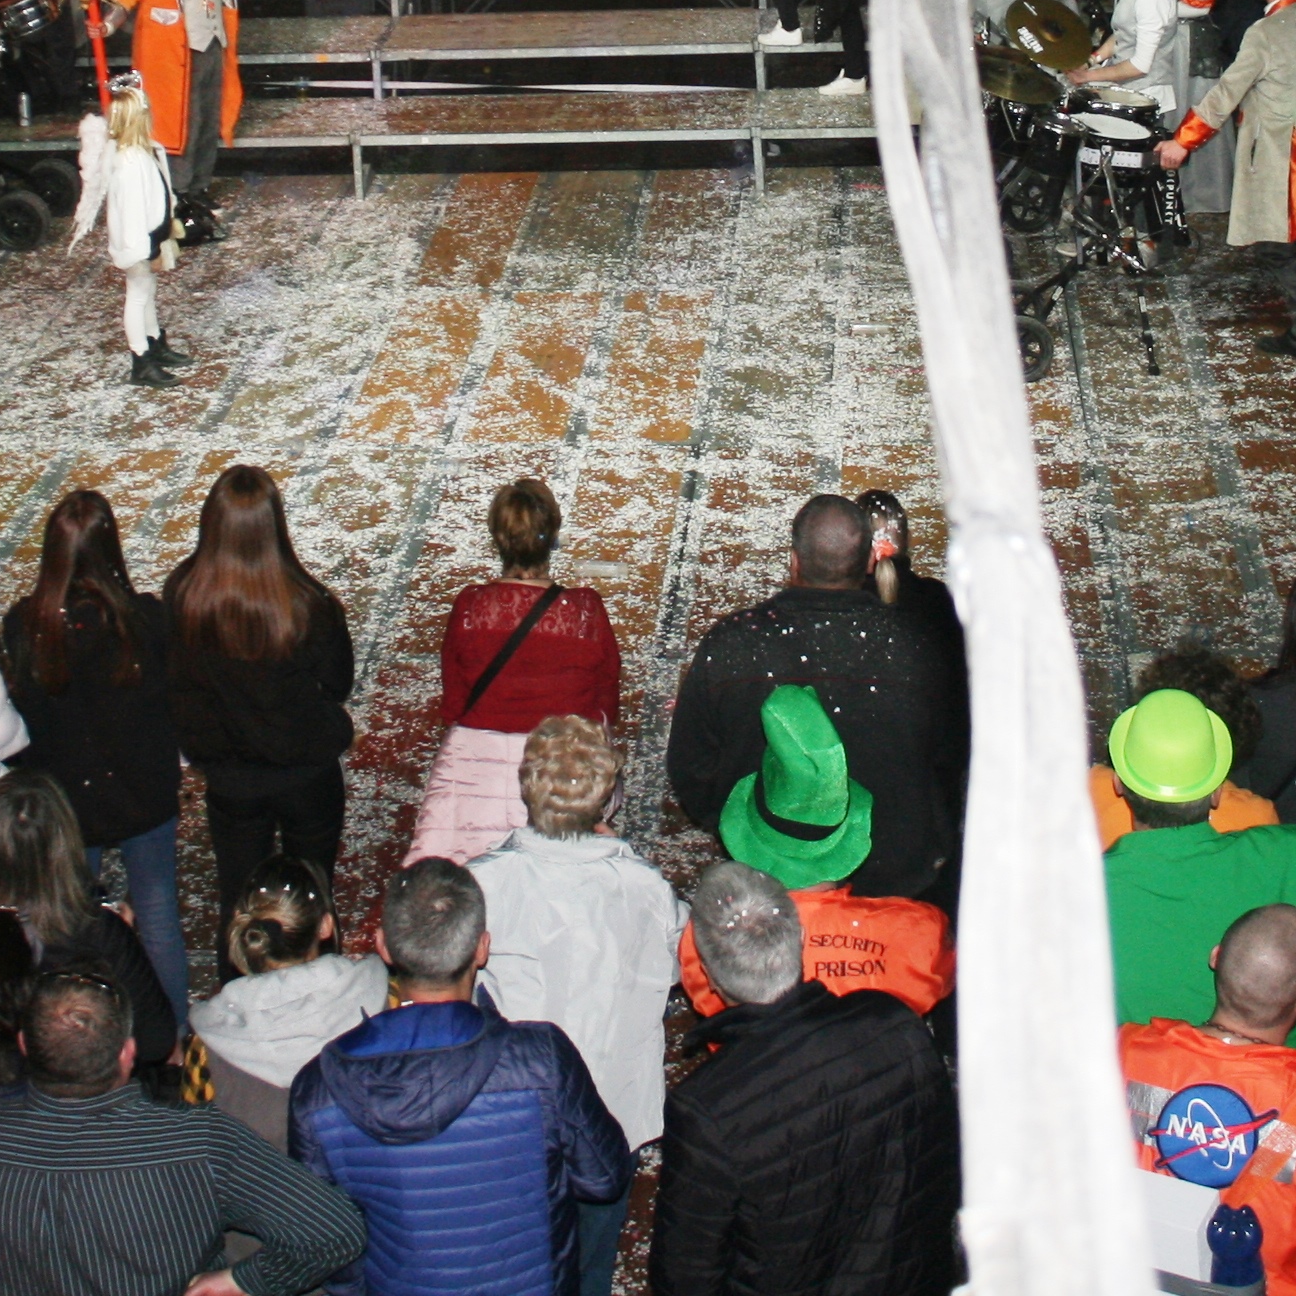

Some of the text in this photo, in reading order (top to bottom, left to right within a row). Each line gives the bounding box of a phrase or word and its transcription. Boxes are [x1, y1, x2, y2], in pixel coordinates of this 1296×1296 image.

[809, 934, 887, 957] SECURITY
[815, 959, 886, 978] PRISON
[1165, 1113, 1247, 1156] NASA
